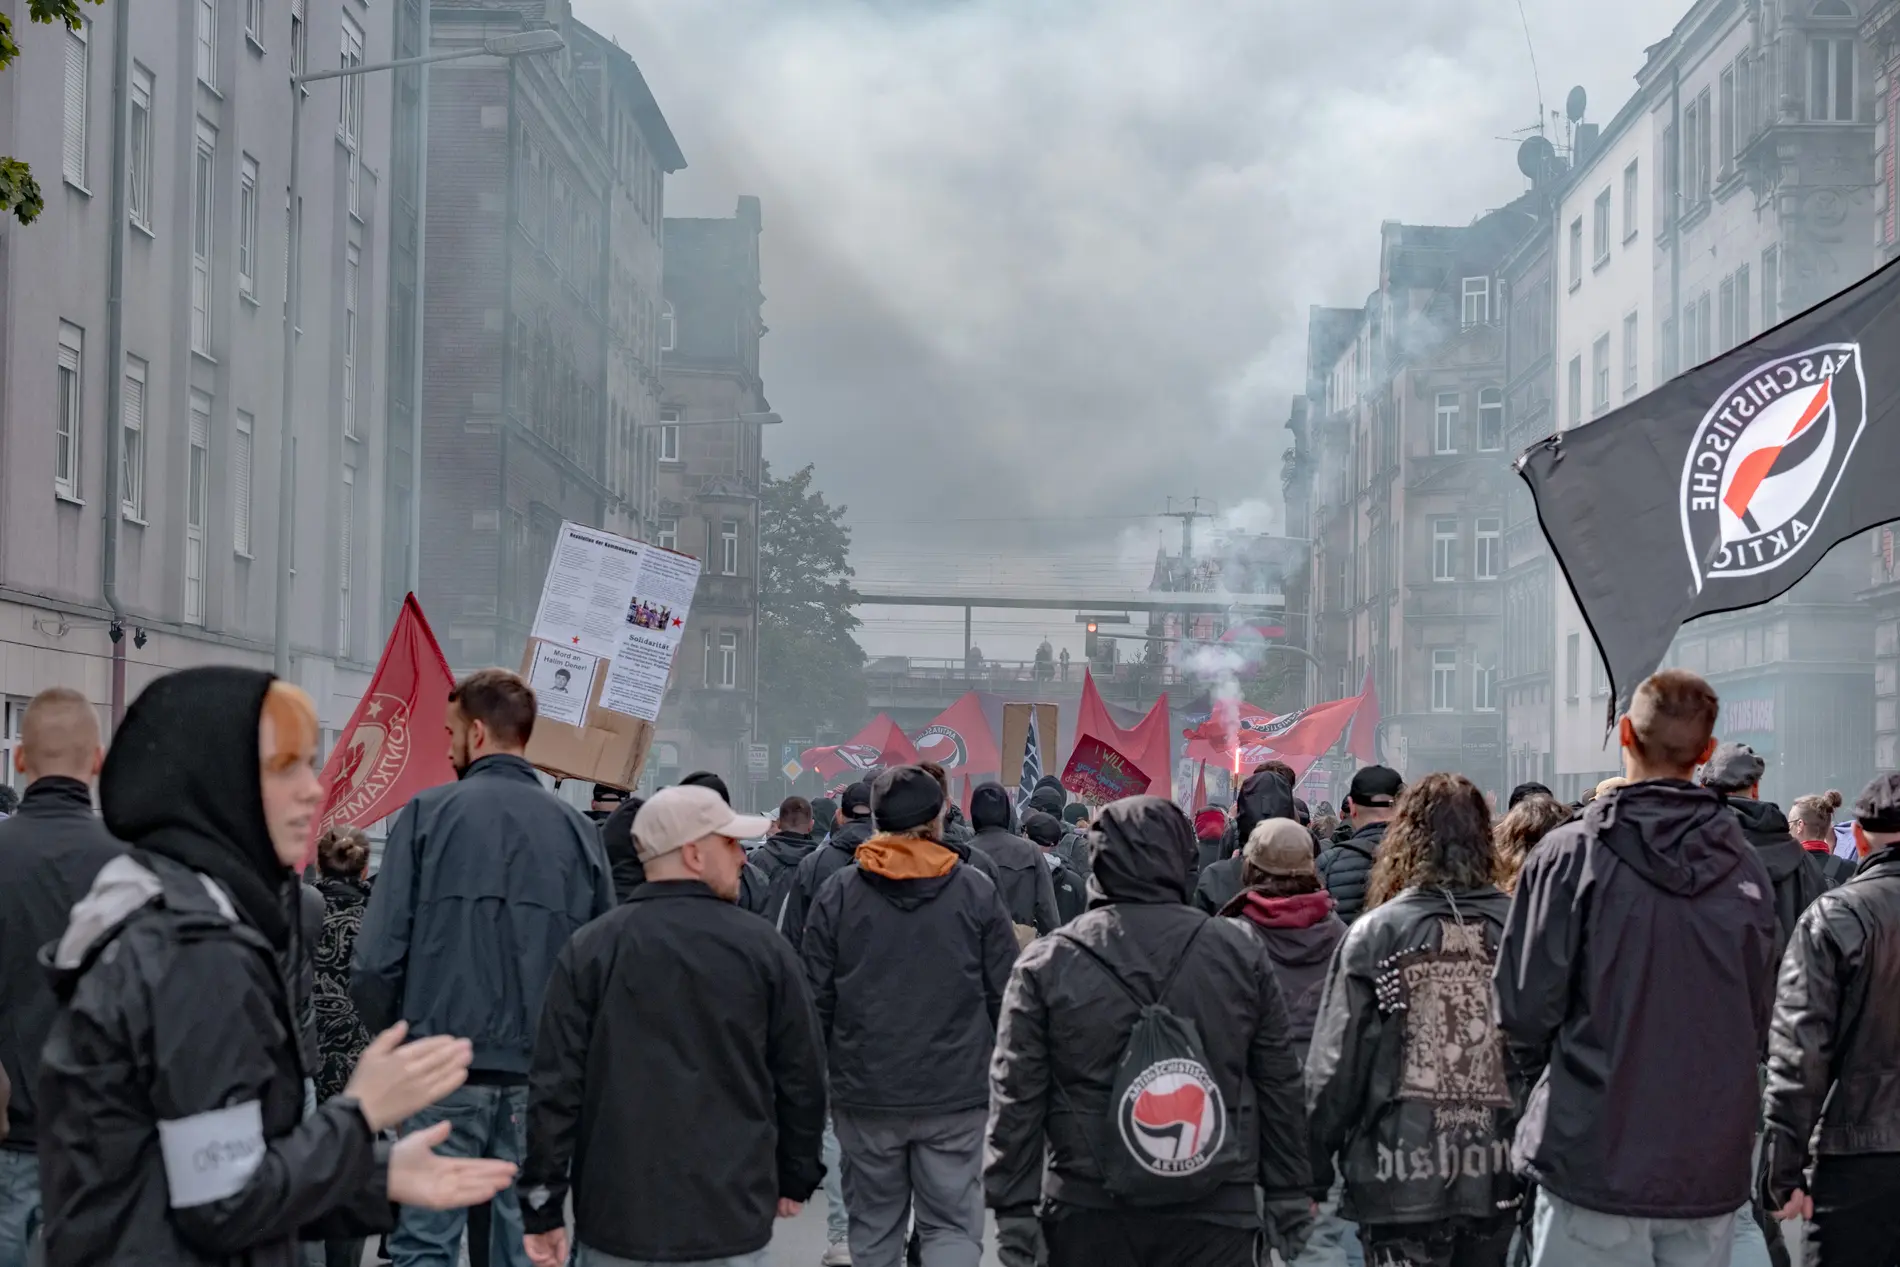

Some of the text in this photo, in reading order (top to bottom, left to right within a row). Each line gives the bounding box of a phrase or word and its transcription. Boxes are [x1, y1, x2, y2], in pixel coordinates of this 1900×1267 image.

[628, 634, 670, 651] Solidarität
[543, 656, 564, 666] Halim
[553, 649, 572, 659] Mord
[1102, 748, 1125, 774] WILL
[1151, 1153, 1205, 1172] AKTION
